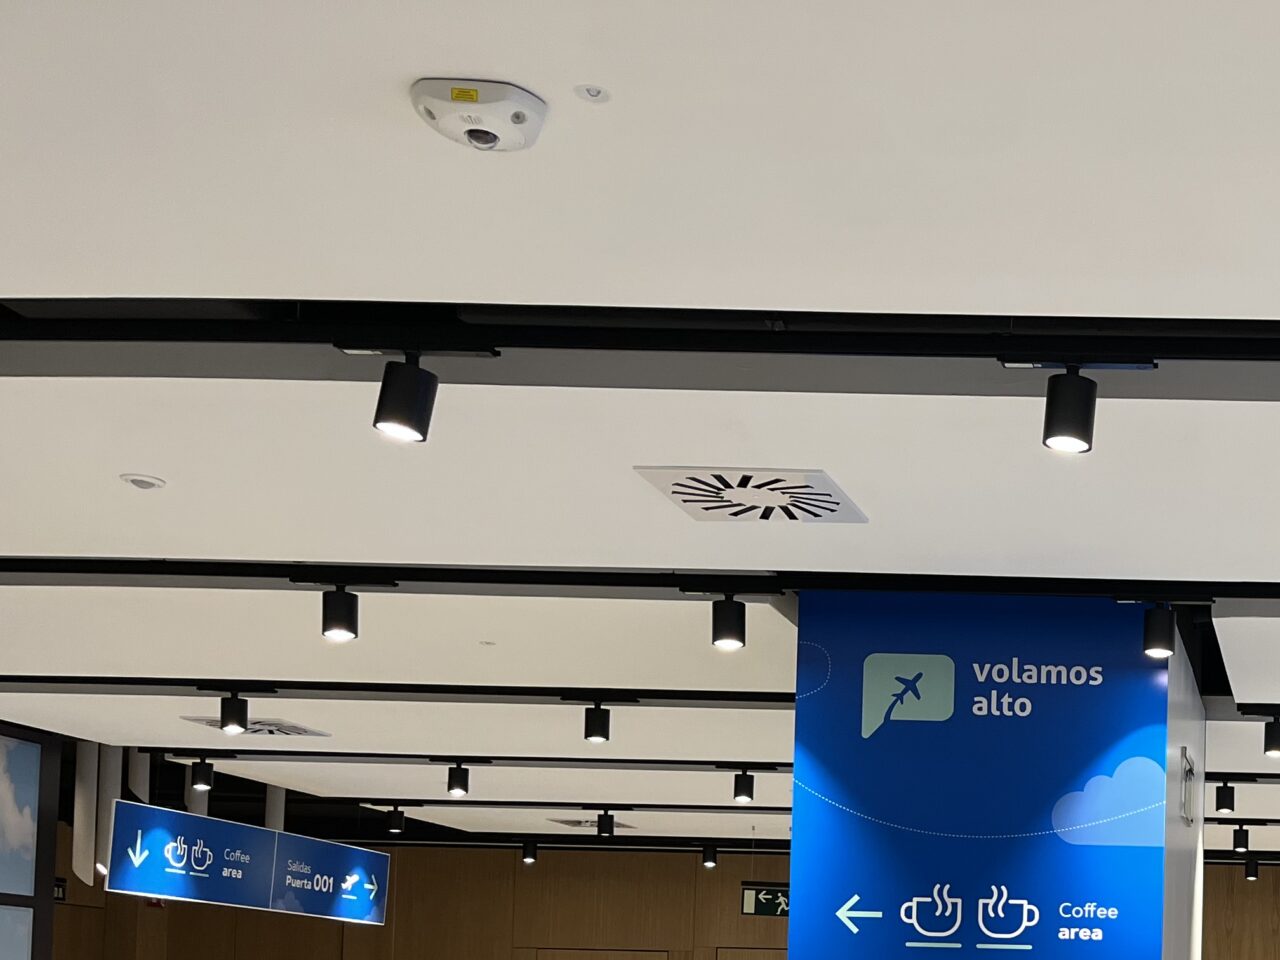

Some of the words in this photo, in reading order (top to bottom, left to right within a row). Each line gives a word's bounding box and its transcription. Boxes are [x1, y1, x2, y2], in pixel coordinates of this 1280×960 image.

[972, 657, 1103, 686] volamos
[972, 690, 1032, 717] alto
[224, 849, 250, 863] Coffee
[222, 868, 242, 878] area
[288, 859, 311, 874] Salidas
[285, 875, 312, 890] Puerta
[313, 874, 333, 893] 001
[1059, 902, 1118, 919] Coffee
[1058, 927, 1103, 940] area
